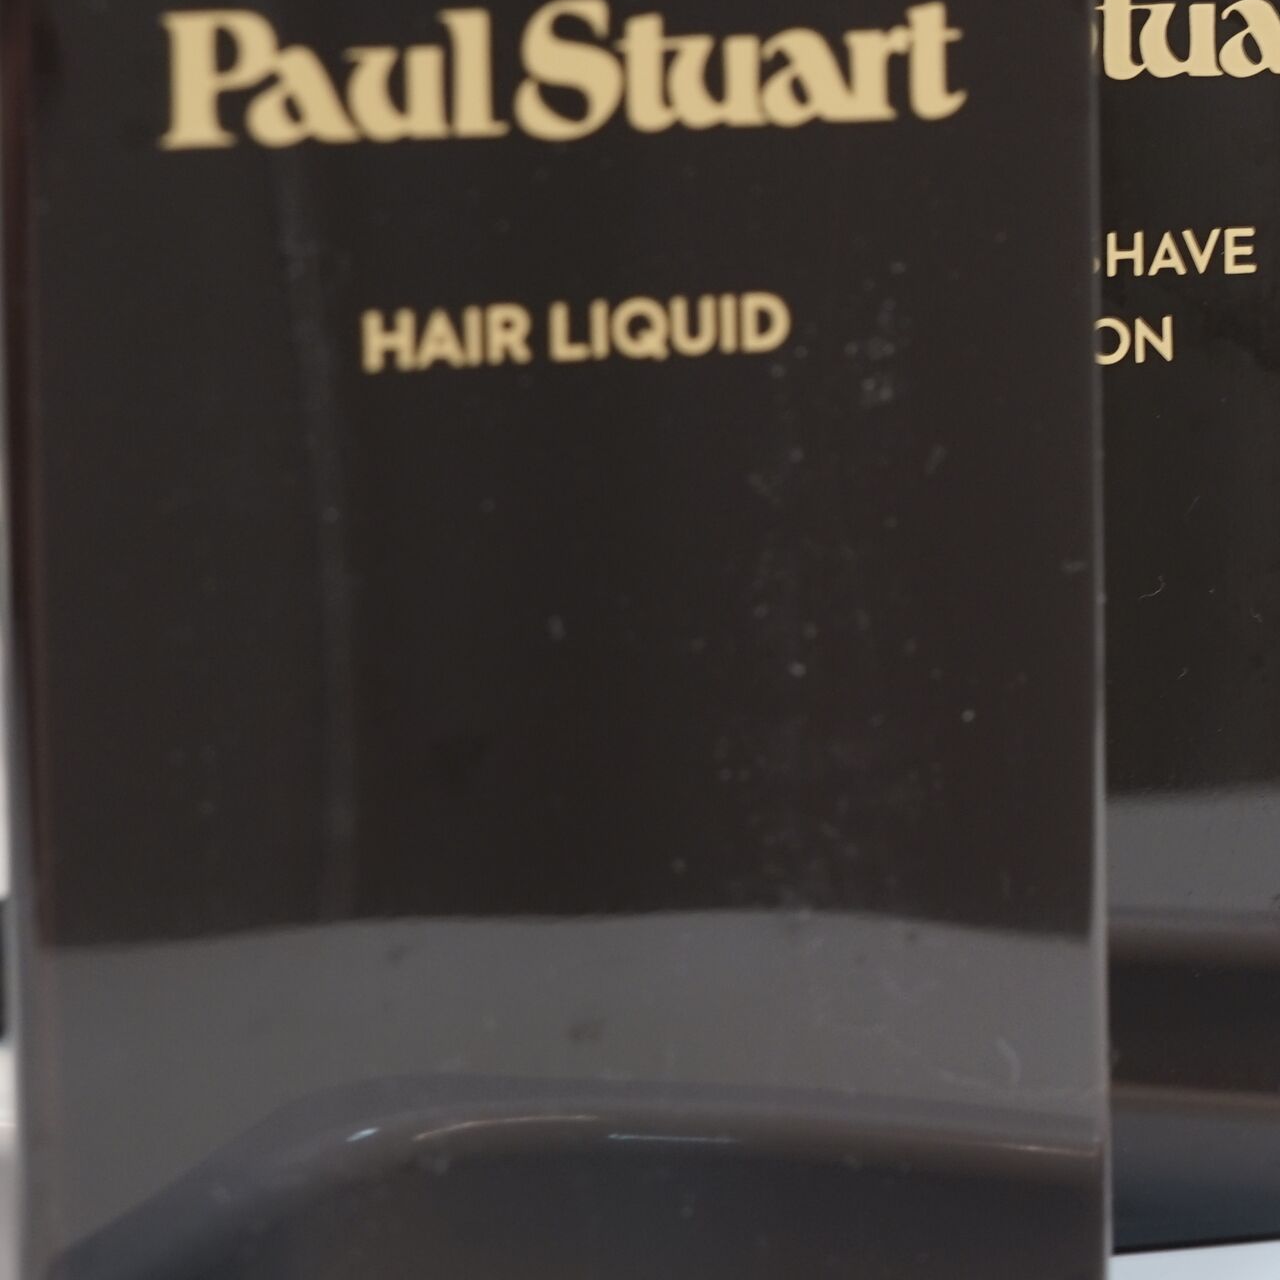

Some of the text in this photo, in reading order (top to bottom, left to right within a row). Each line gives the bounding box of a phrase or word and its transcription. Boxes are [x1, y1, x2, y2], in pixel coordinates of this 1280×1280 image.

[159, 7, 509, 151] Paul
[1093, 226, 1258, 278] HAVE
[361, 291, 792, 373] HAIR LIQUID
